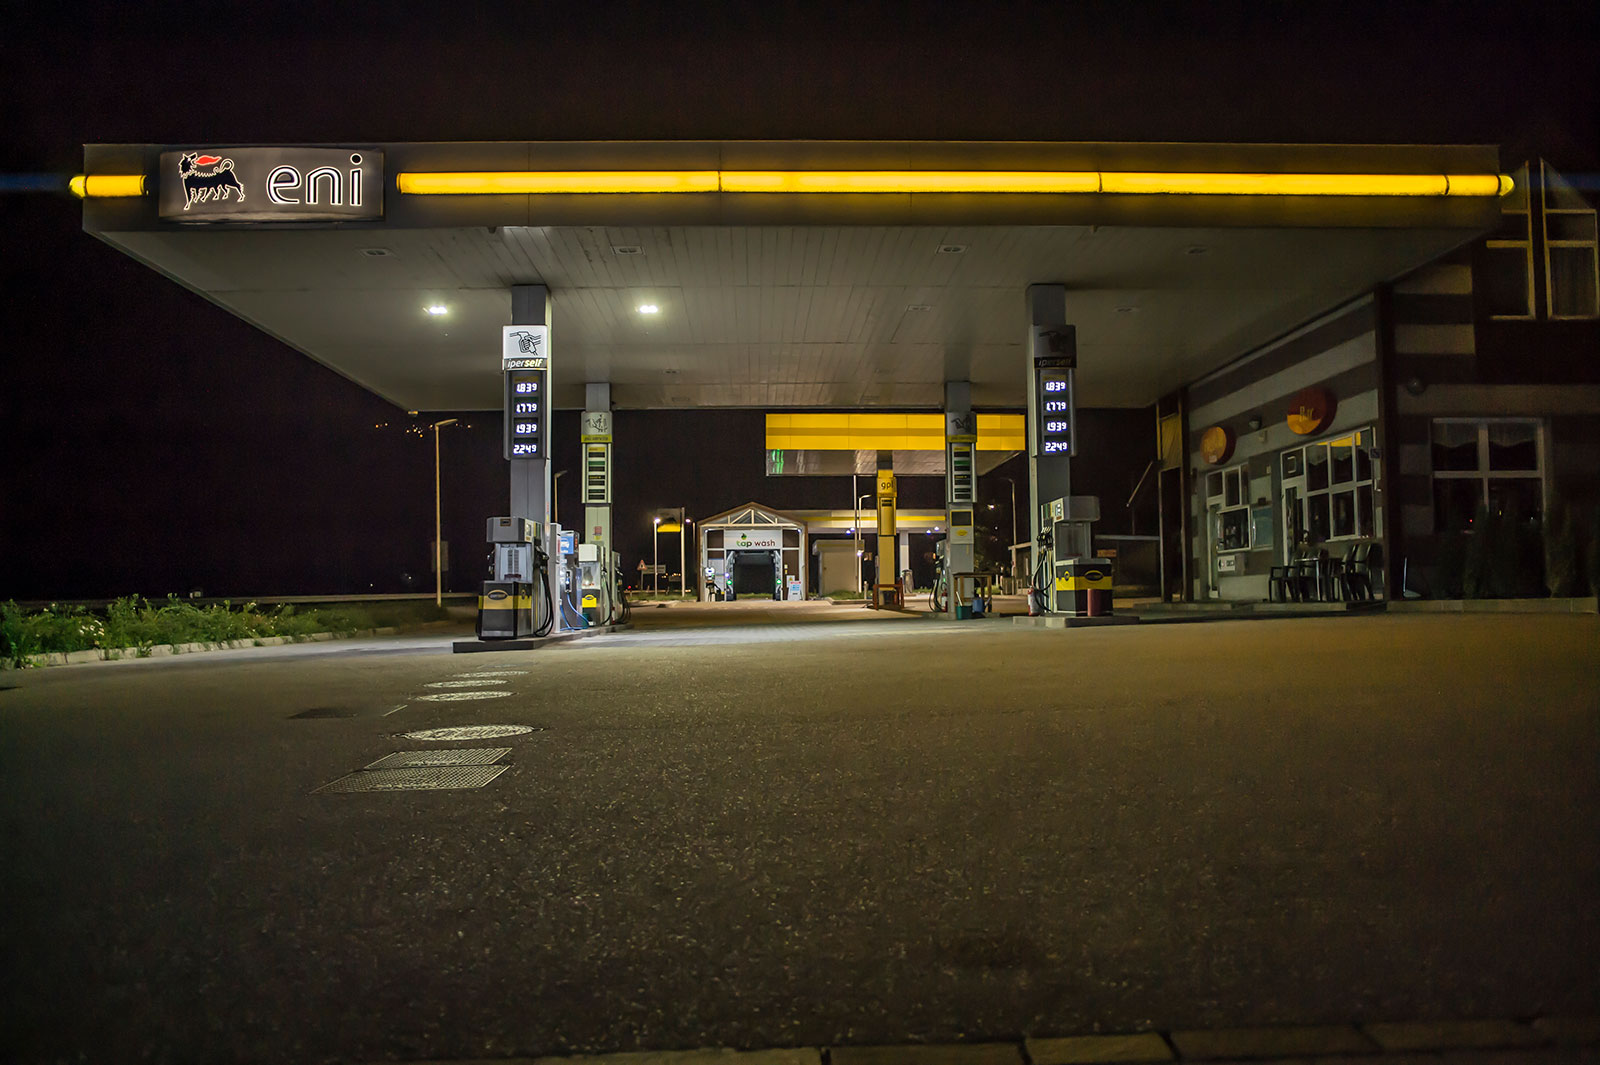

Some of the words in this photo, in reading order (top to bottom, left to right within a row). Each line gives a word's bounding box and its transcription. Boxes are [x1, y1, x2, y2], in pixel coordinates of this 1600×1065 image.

[265, 152, 363, 206] eni
[507, 359, 543, 369] iperself
[754, 539, 775, 547] wash
